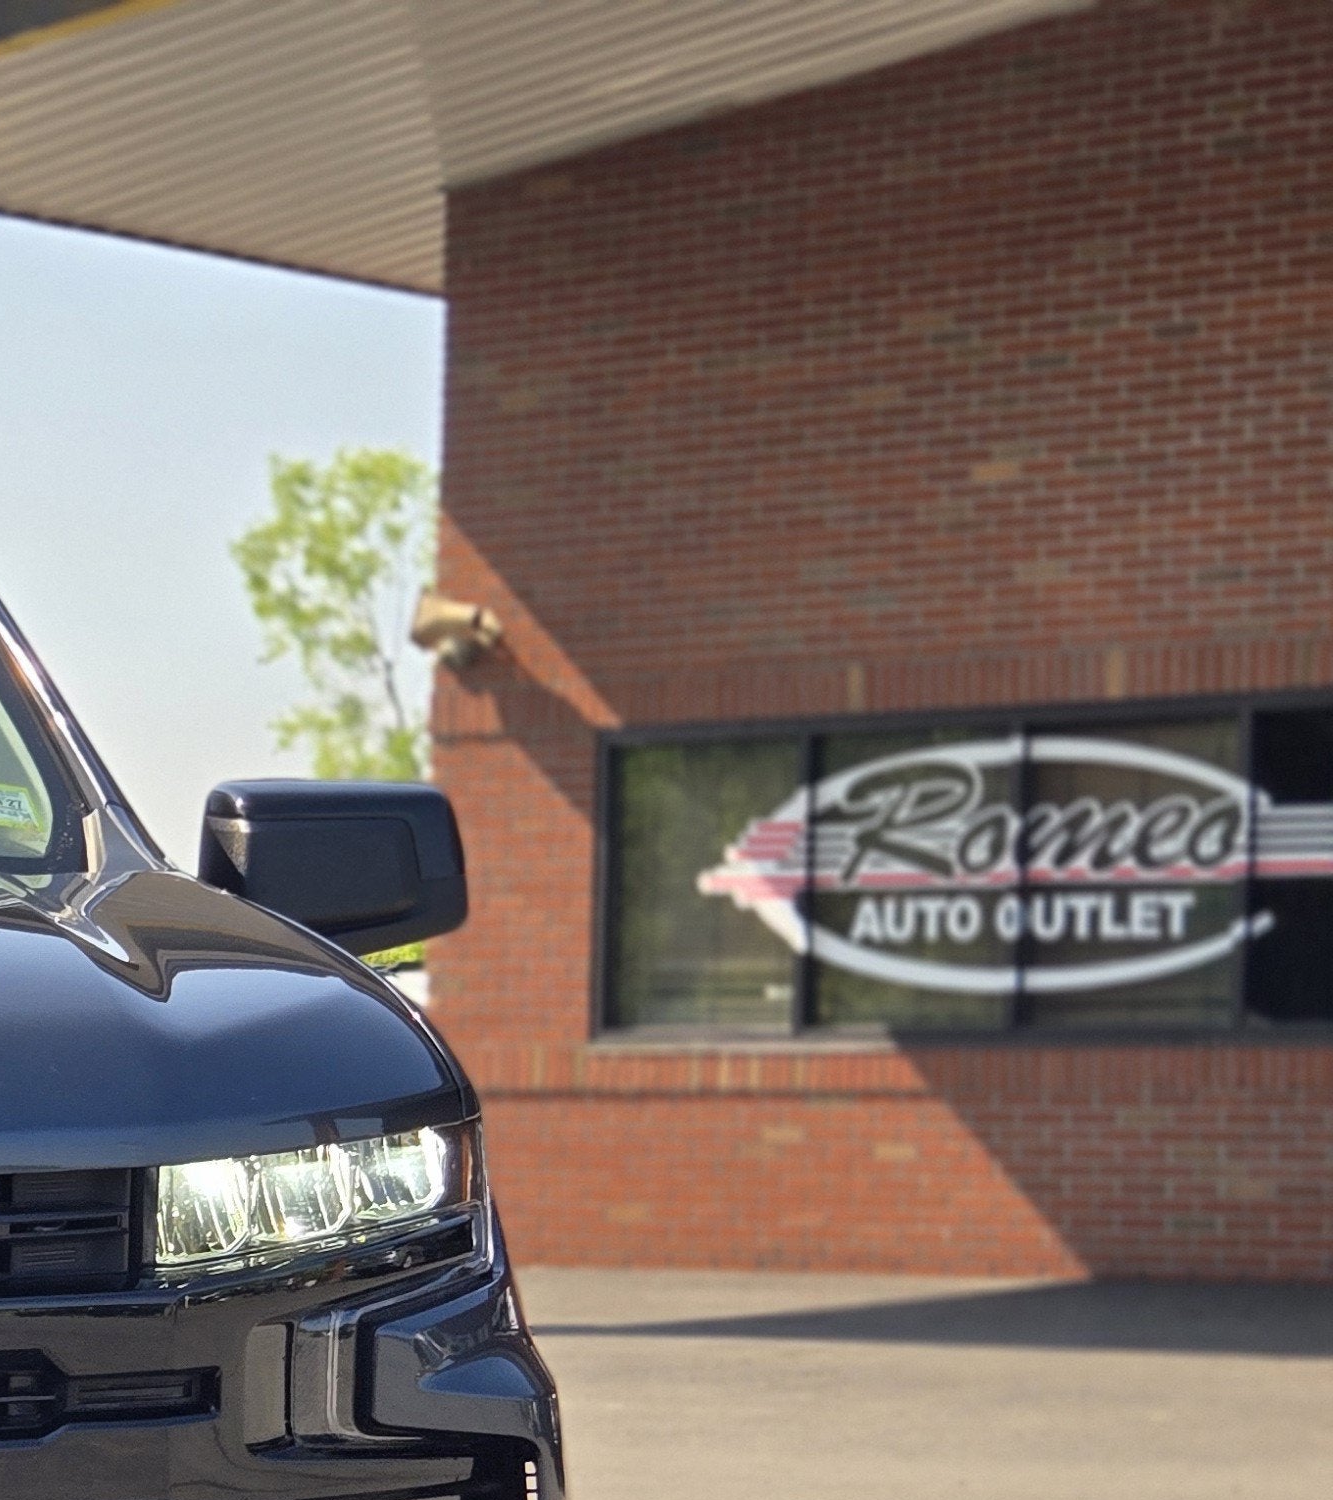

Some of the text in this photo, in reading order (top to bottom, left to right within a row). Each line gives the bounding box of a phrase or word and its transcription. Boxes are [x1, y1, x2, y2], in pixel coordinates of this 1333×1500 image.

[814, 759, 1247, 884] Romeo
[849, 893, 1194, 943] AUTO OUTLET
